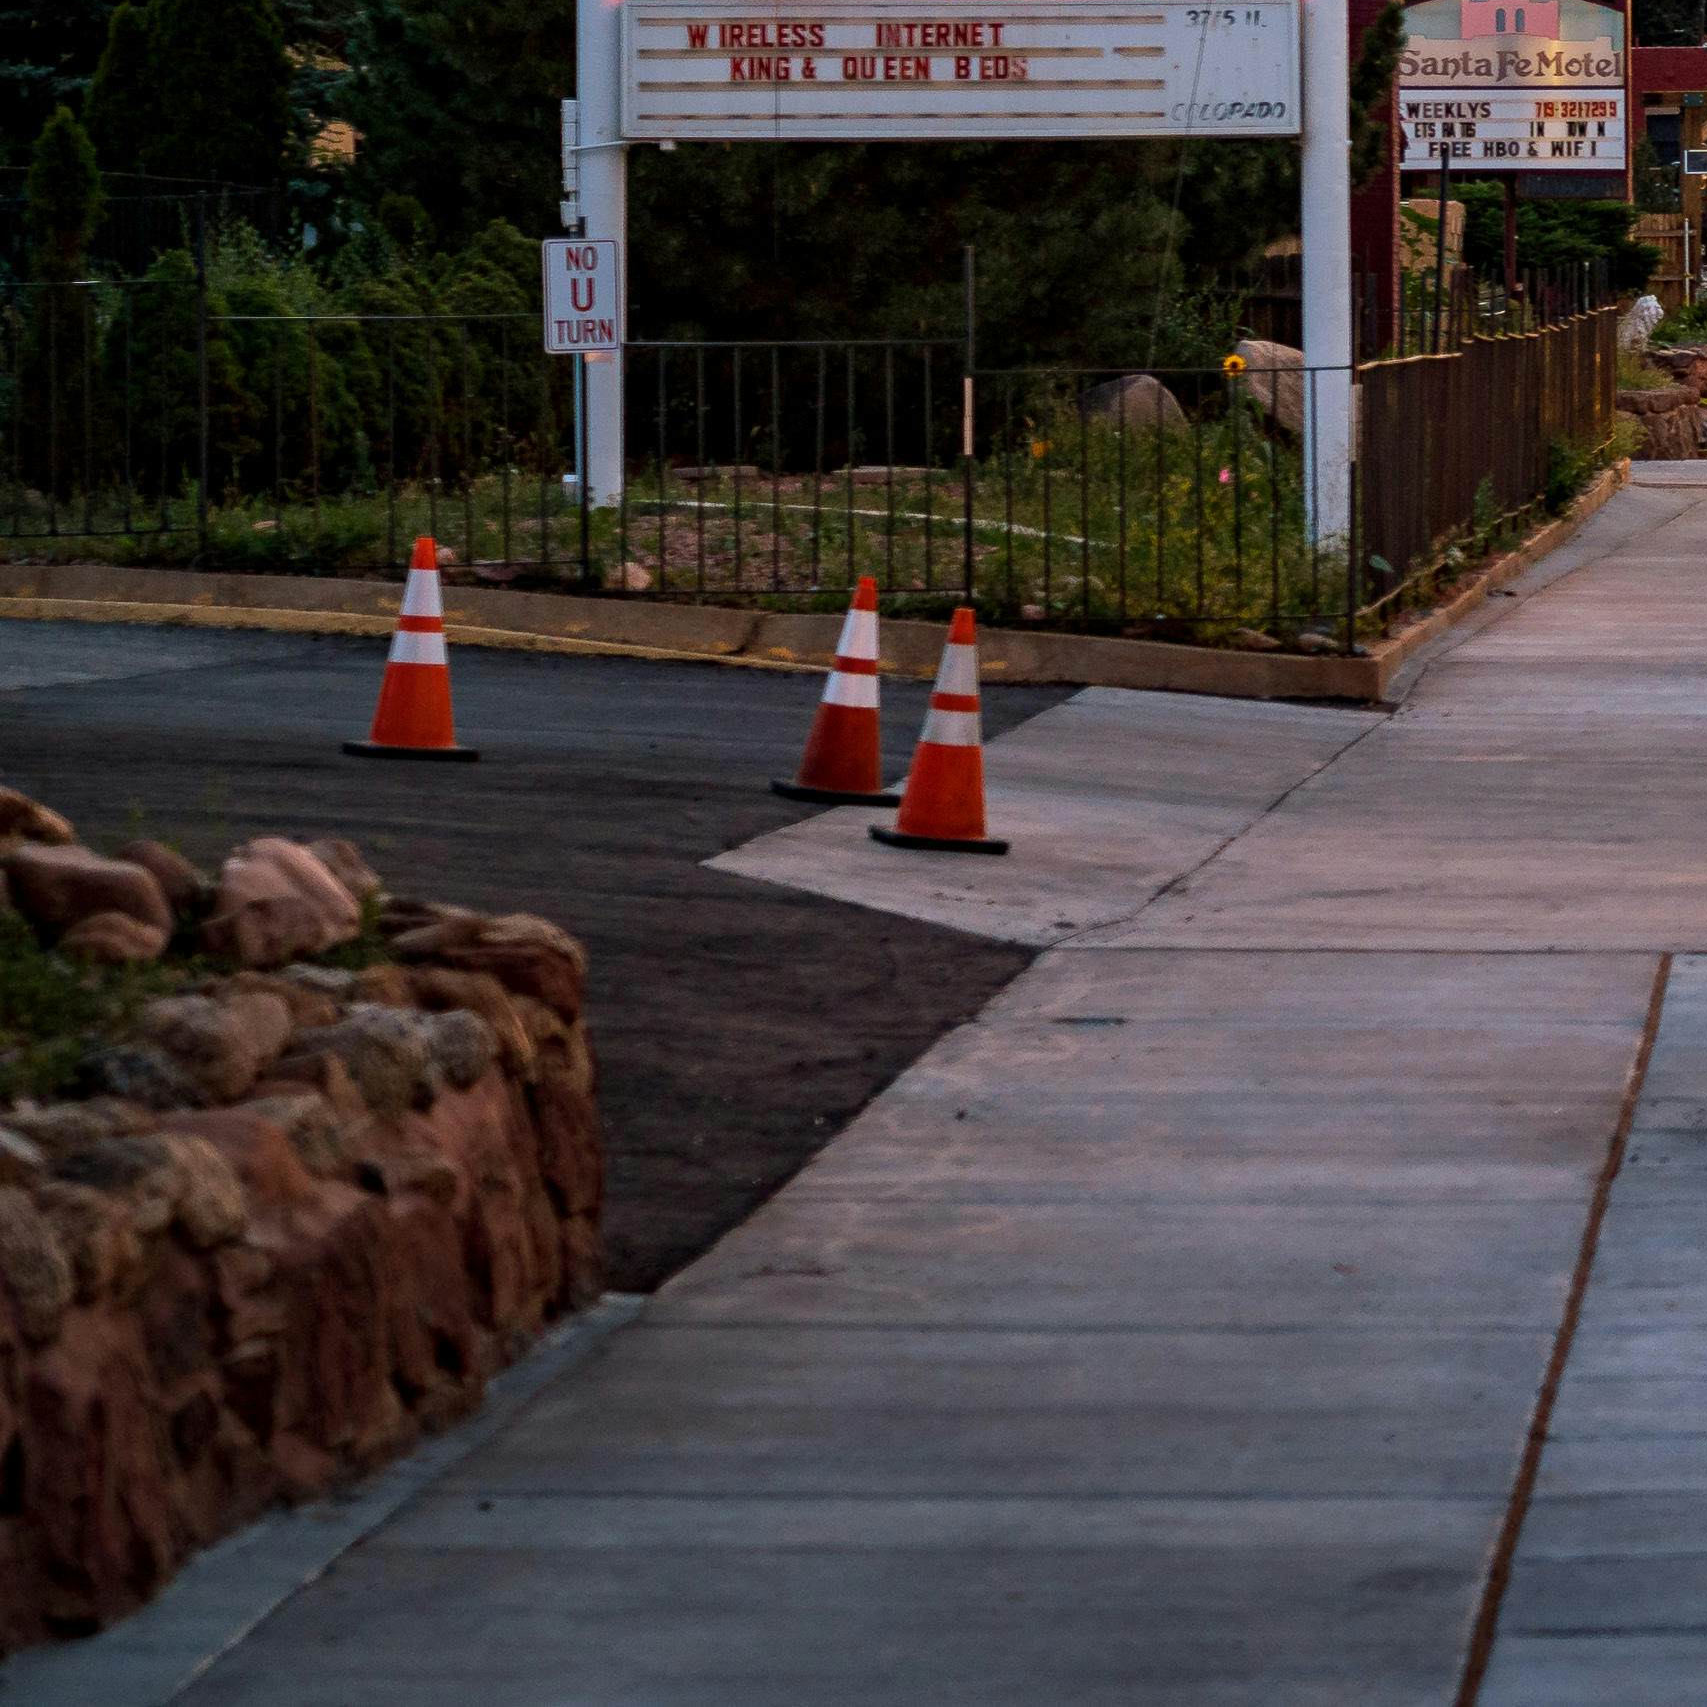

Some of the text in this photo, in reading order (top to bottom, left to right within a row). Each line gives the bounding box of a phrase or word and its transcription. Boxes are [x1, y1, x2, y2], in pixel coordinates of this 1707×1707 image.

[686, 22, 1005, 49] WIRELESS INTERNET
[729, 55, 1028, 81] KING & QUEEN BEDS
[1399, 49, 1623, 82] Santa Fe Motel
[1405, 101, 1491, 119] WEEKLYS
[1428, 141, 1472, 158] FREE
[1483, 141, 1520, 158] HBO
[1527, 141, 1538, 157] &
[565, 245, 599, 271] NO
[570, 277, 596, 312] U
[554, 319, 615, 344] TURN
